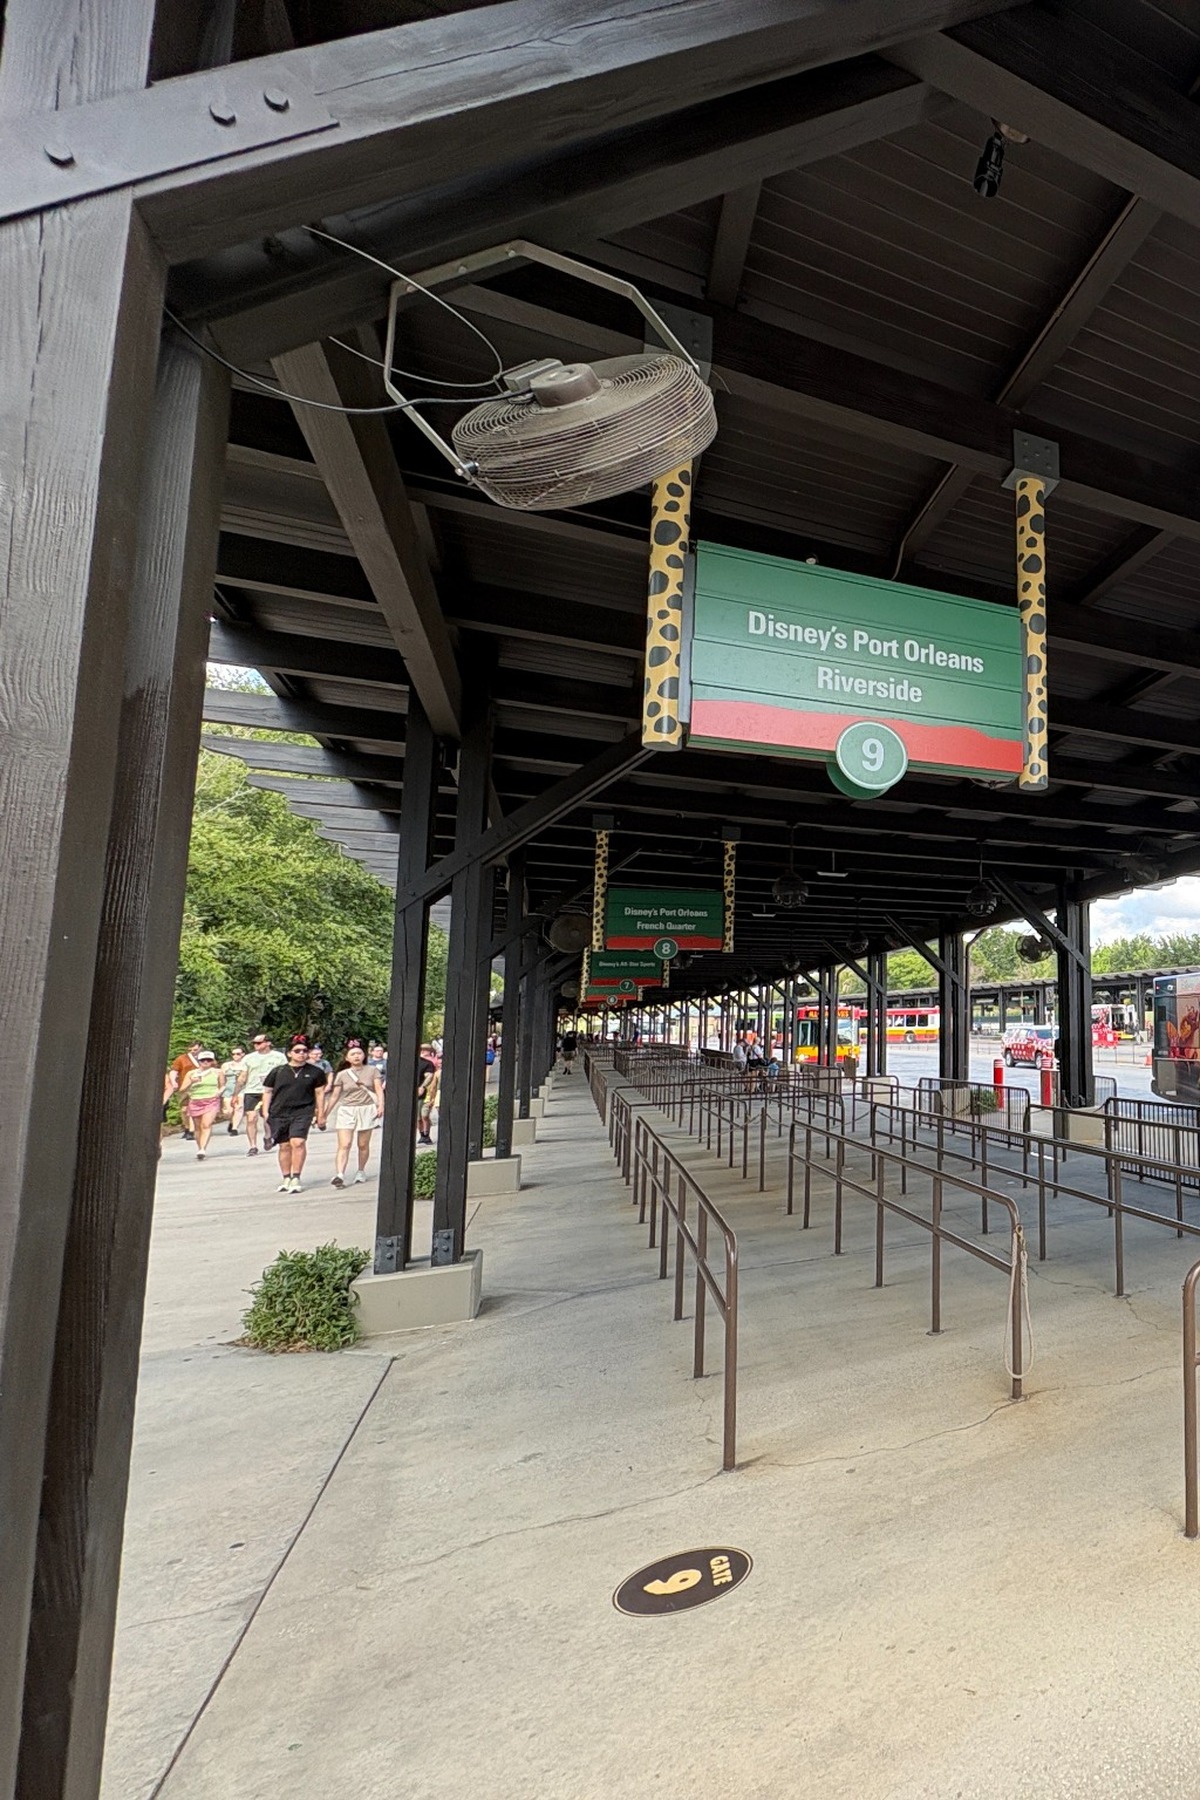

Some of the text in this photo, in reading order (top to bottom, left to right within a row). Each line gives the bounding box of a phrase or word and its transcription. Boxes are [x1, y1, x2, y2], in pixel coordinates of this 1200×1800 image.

[748, 611, 985, 673] Disney's Port Orleans
[817, 666, 923, 702] Riverside
[861, 738, 885, 772] 9
[624, 907, 708, 918] Disney's Port Orleans
[637, 921, 696, 930] French Quarter
[662, 942, 671, 954] 8
[624, 981, 630, 989] 7
[709, 1555, 734, 1587] GATE
